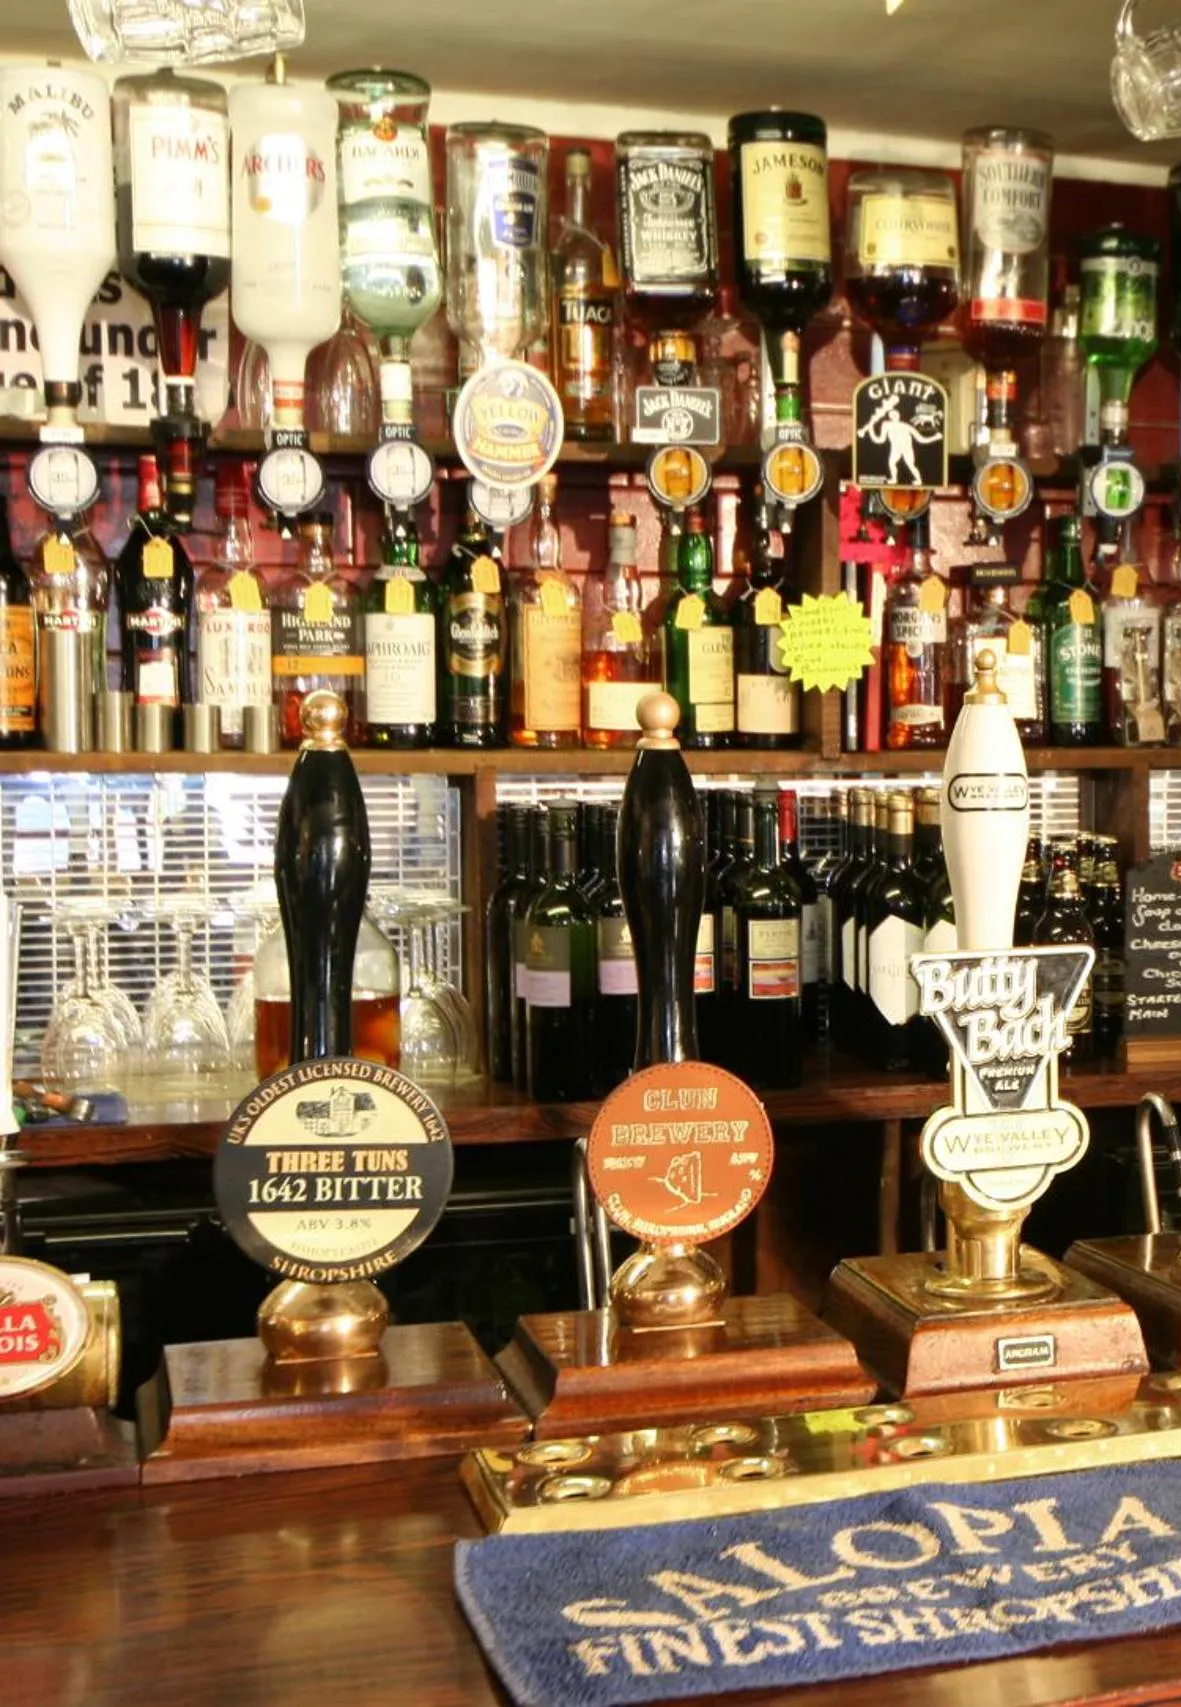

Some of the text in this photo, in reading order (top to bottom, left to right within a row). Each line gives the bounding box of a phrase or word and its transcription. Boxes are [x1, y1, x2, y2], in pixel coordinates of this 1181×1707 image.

[8, 84, 95, 120] MALIBU
[151, 134, 220, 164] PIMM'S
[752, 153, 825, 176] JAMESON
[868, 378, 936, 400] GIANT
[276, 431, 304, 446] OPTIC
[385, 425, 412, 440] OPTIC
[299, 629, 334, 643] PARK
[1131, 904, 1172, 927] Soup
[920, 957, 1039, 1021] Butty
[1128, 1007, 1169, 1021] MAIN
[978, 1063, 1035, 1078] PREMIUM
[994, 1079, 1020, 1092] ALE
[250, 1062, 445, 1143] OLDEST LICENSED BREWERY 1642
[643, 1087, 719, 1112] CLUN
[610, 1119, 750, 1147] BREWERY
[944, 1132, 994, 1154] WYE
[265, 1149, 409, 1174] THREE TUNS
[248, 1175, 424, 1204] 1642 BITTER
[296, 1217, 329, 1230] ABV
[269, 1249, 398, 1282] SHROPSHIRE
[567, 1610, 844, 1677] FINEST
